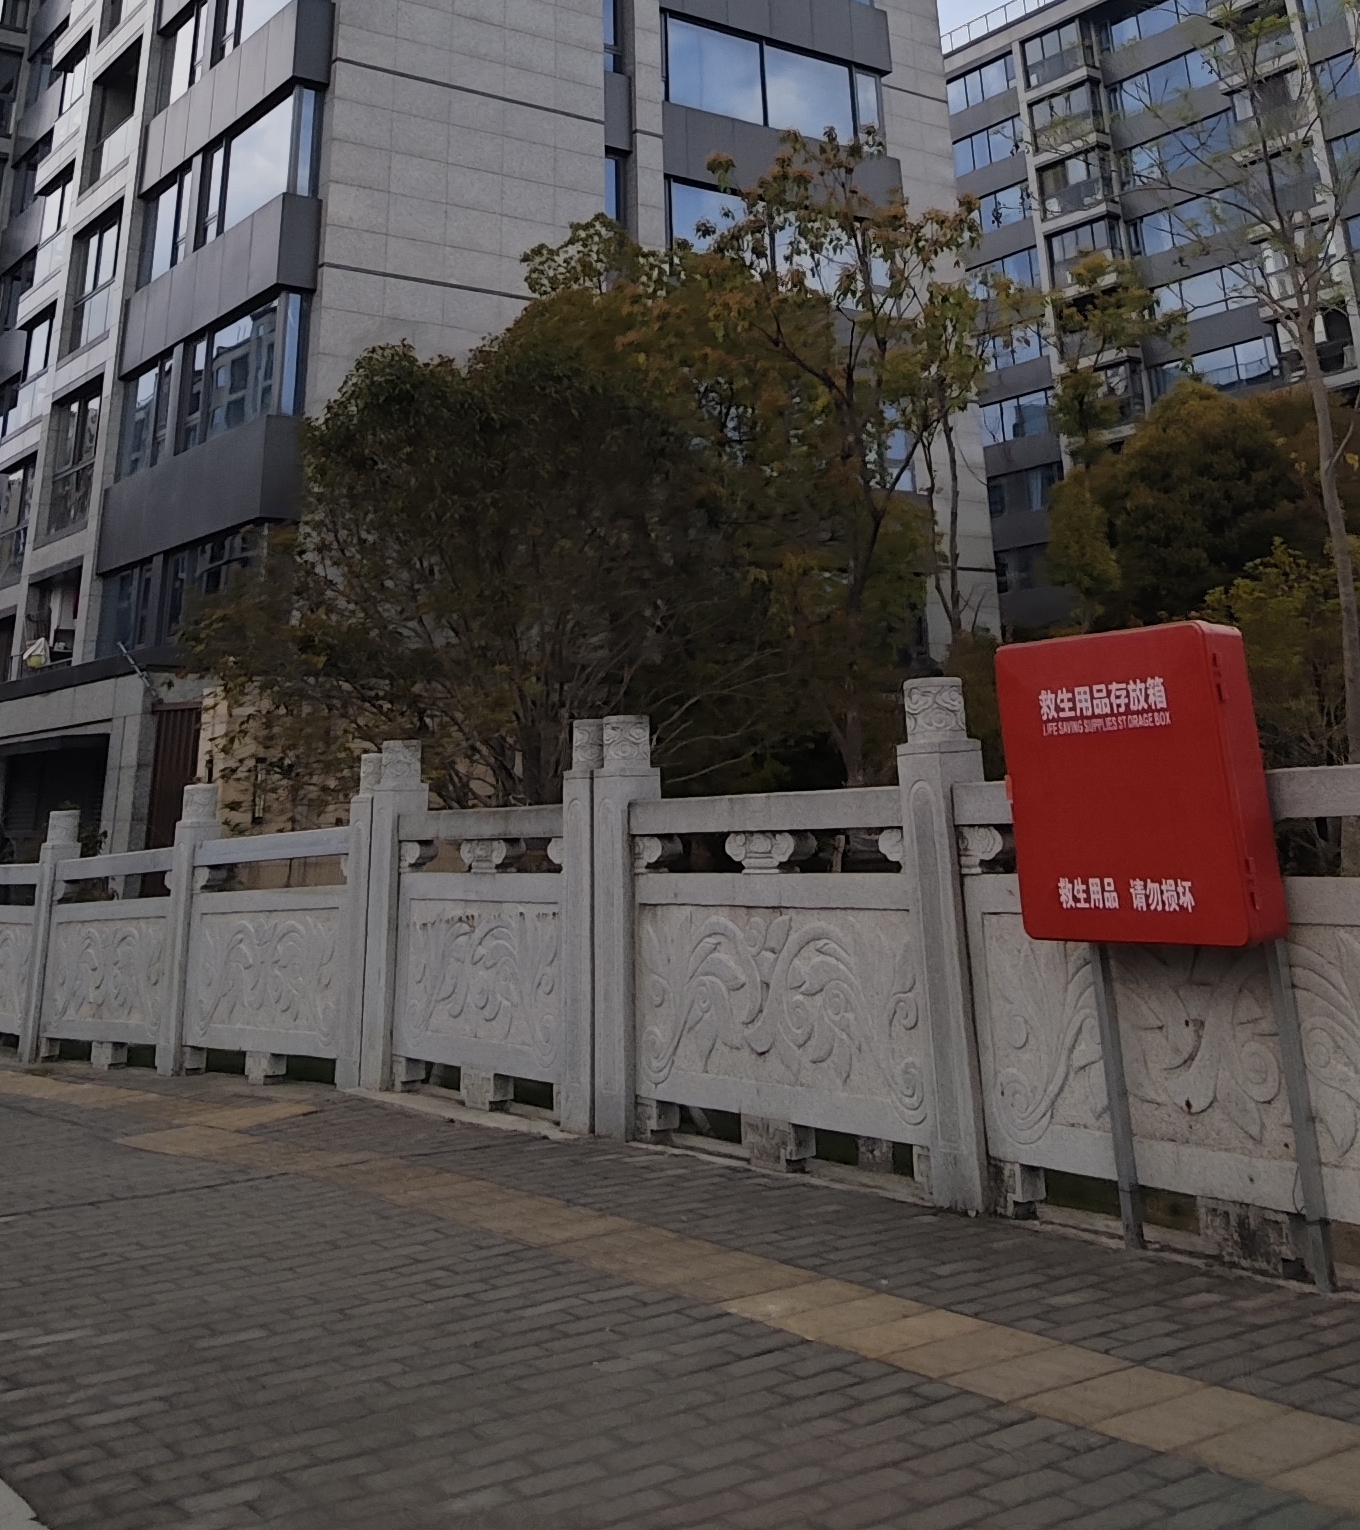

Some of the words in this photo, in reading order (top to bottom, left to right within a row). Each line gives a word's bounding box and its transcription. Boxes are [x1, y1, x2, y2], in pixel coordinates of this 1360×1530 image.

[1039, 676, 1168, 721] 救生用品存放箱
[1043, 722, 1058, 737] LIFE
[1058, 719, 1083, 735] SAVING
[1084, 716, 1117, 733] SUPPLIES
[1154, 710, 1171, 726] BOX
[1058, 876, 1120, 910] 救生用品
[1129, 878, 1196, 913] 请勿损坏
